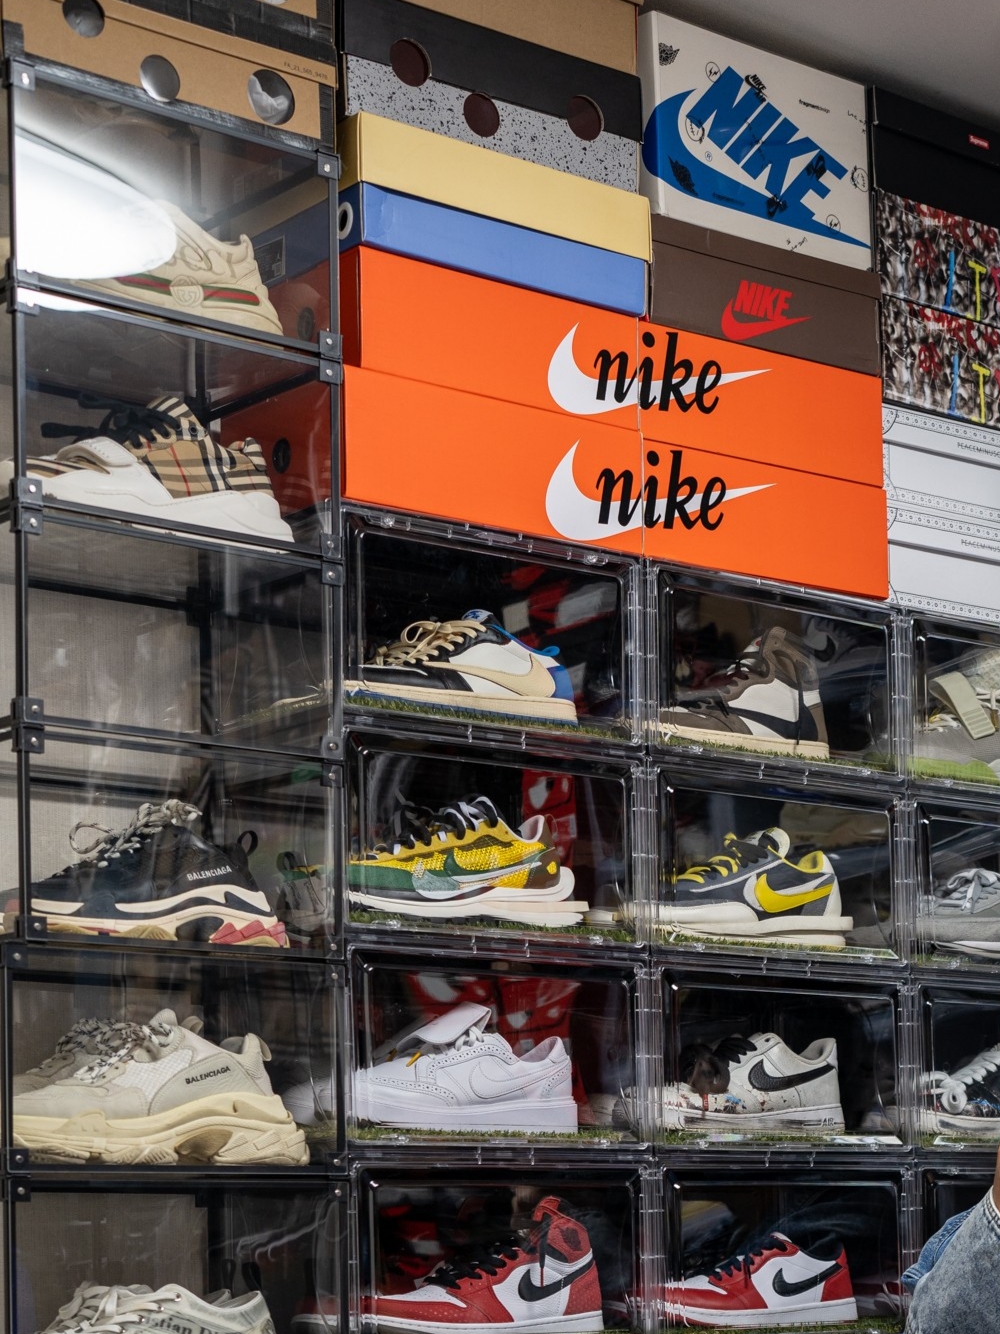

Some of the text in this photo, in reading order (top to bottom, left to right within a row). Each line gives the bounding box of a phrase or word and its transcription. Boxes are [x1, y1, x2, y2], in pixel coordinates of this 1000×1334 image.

[750, 74, 767, 91] NIKE
[686, 66, 849, 218] NIKE
[733, 279, 793, 321] NIKE
[593, 331, 723, 415] nike
[596, 450, 727, 531] nike
[187, 865, 233, 882] BALENCIAGA
[185, 1065, 232, 1086] BALENCIAGA
